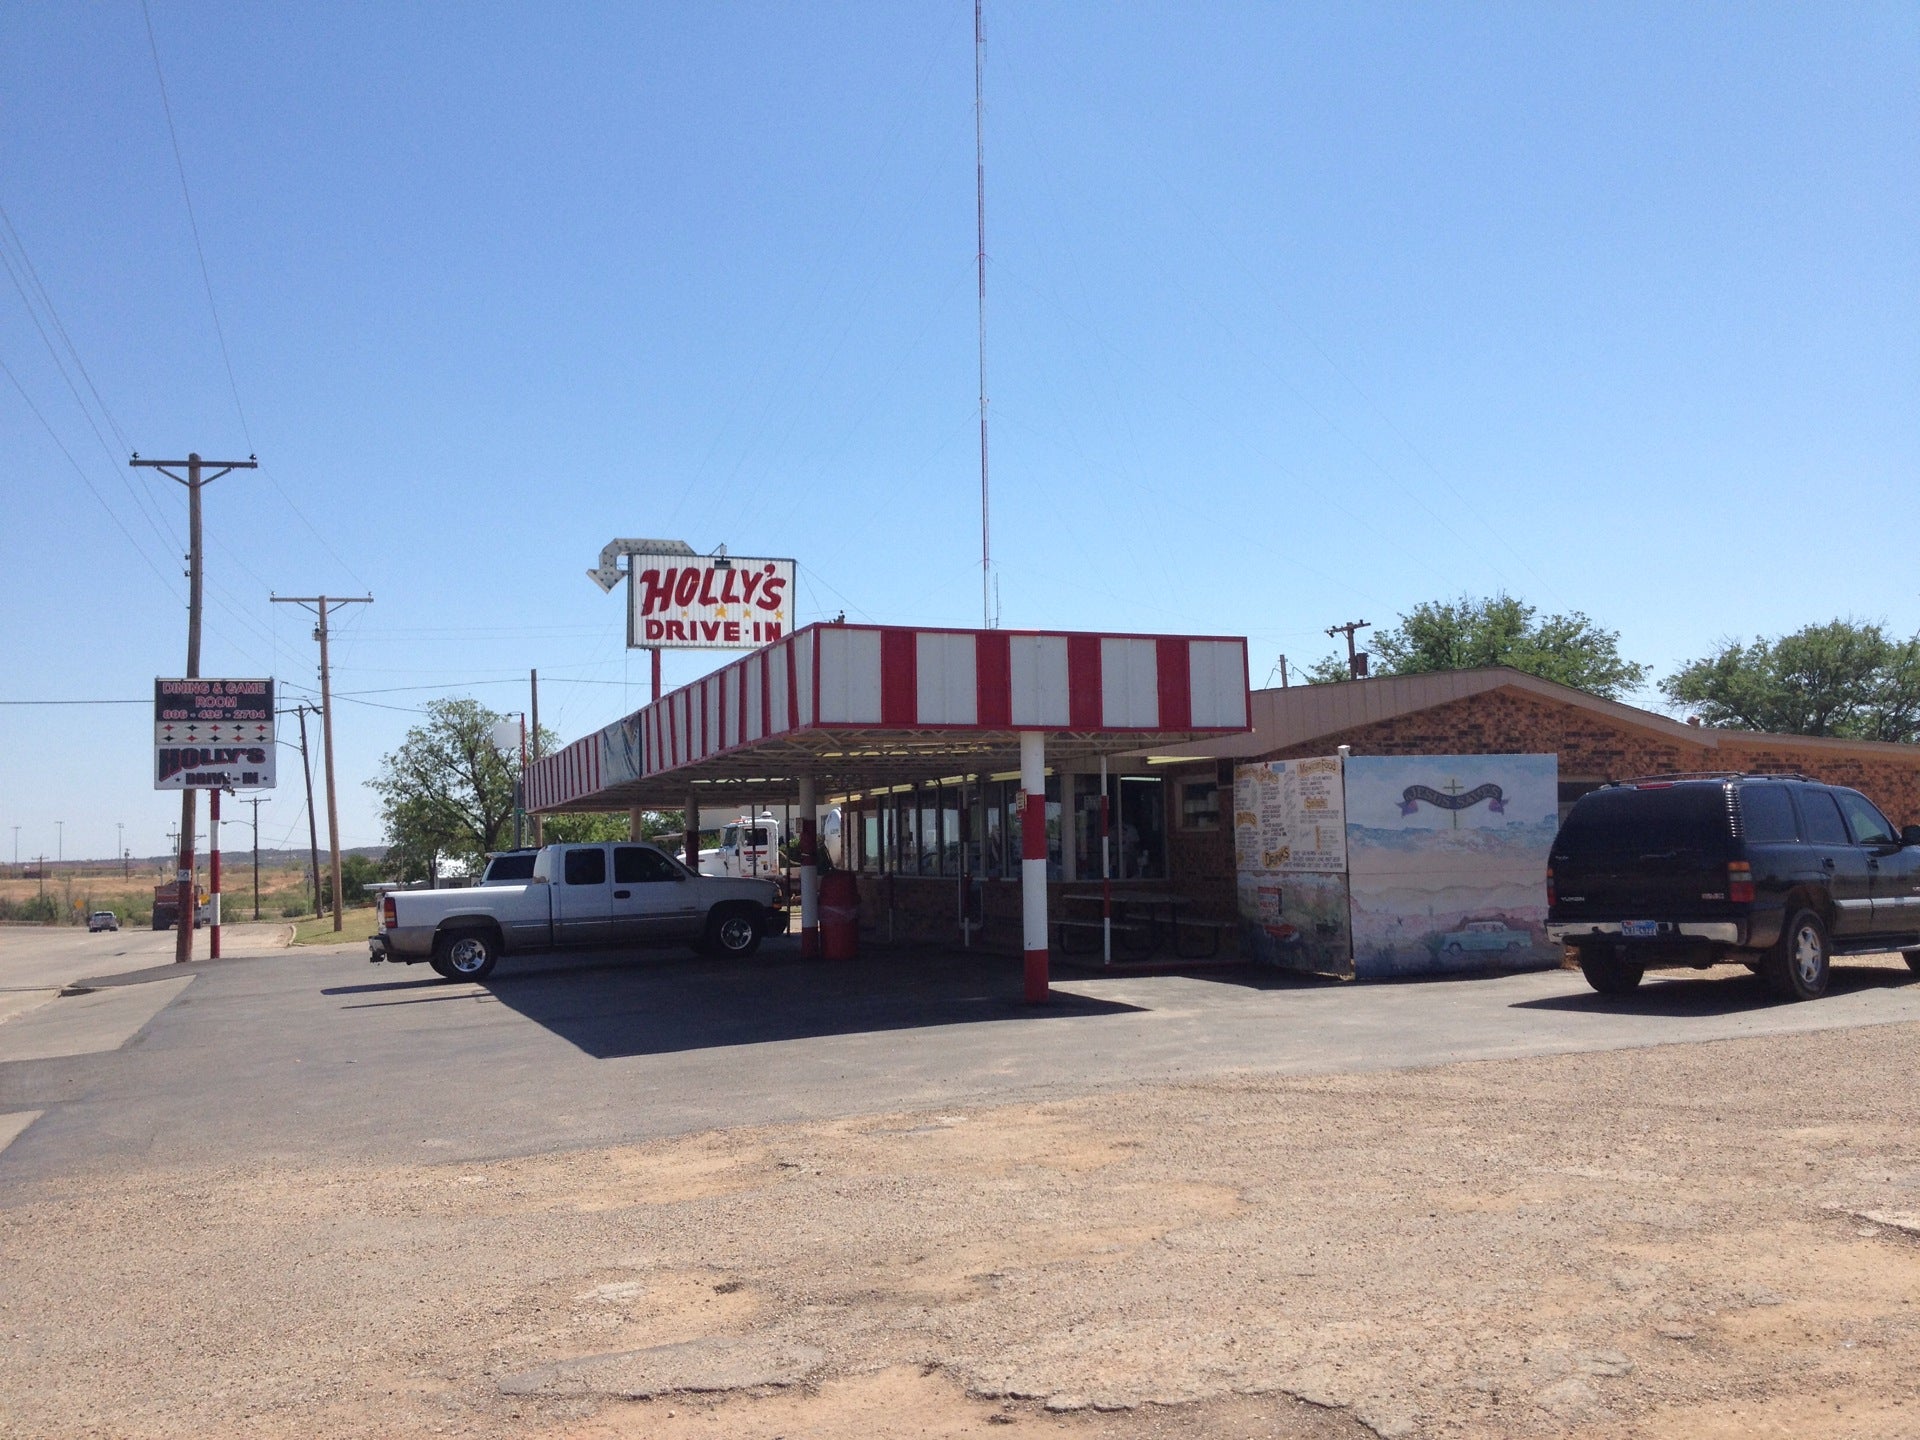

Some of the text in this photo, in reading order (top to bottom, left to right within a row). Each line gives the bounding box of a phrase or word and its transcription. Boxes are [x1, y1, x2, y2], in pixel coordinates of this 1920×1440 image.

[640, 563, 787, 616] HOLLY'S
[163, 682, 266, 694] DINING & GAME
[195, 696, 237, 708] ROOM
[159, 748, 266, 782] HOLLY'S
[1407, 785, 1500, 807] JESUS SAVES
